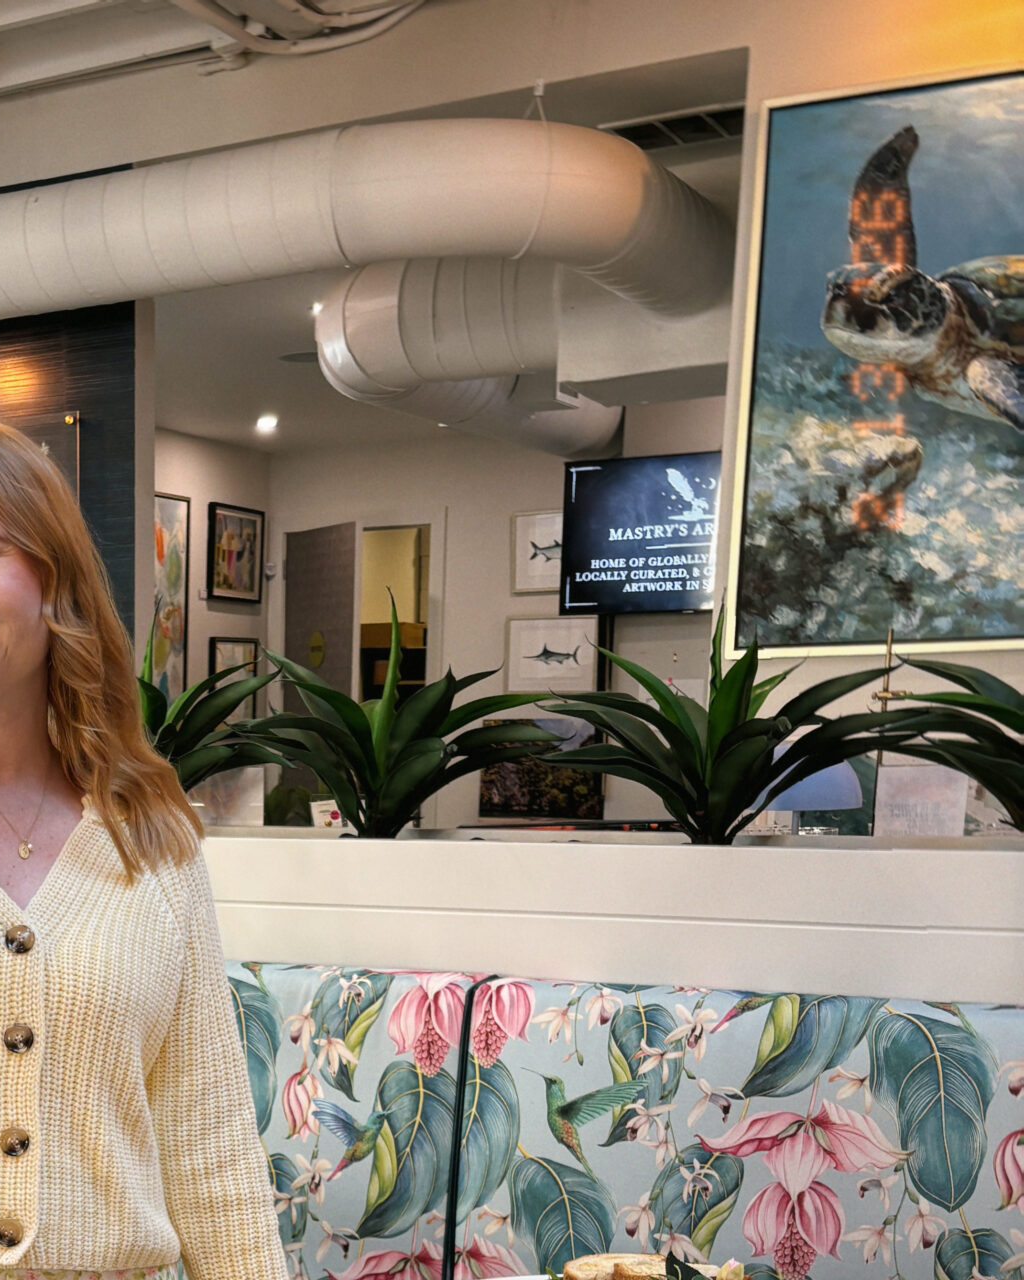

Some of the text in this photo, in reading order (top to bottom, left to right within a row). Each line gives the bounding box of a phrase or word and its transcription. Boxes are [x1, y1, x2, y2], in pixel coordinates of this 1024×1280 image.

[609, 522, 714, 541] MASTRY'S AR
[591, 553, 709, 569] HOME OF GLOBALLY
[576, 570, 627, 582] LOCALLY
[631, 568, 690, 580] CURATED,
[692, 567, 701, 577] &
[623, 581, 683, 592] ARTWORK
[686, 580, 700, 590] IN
